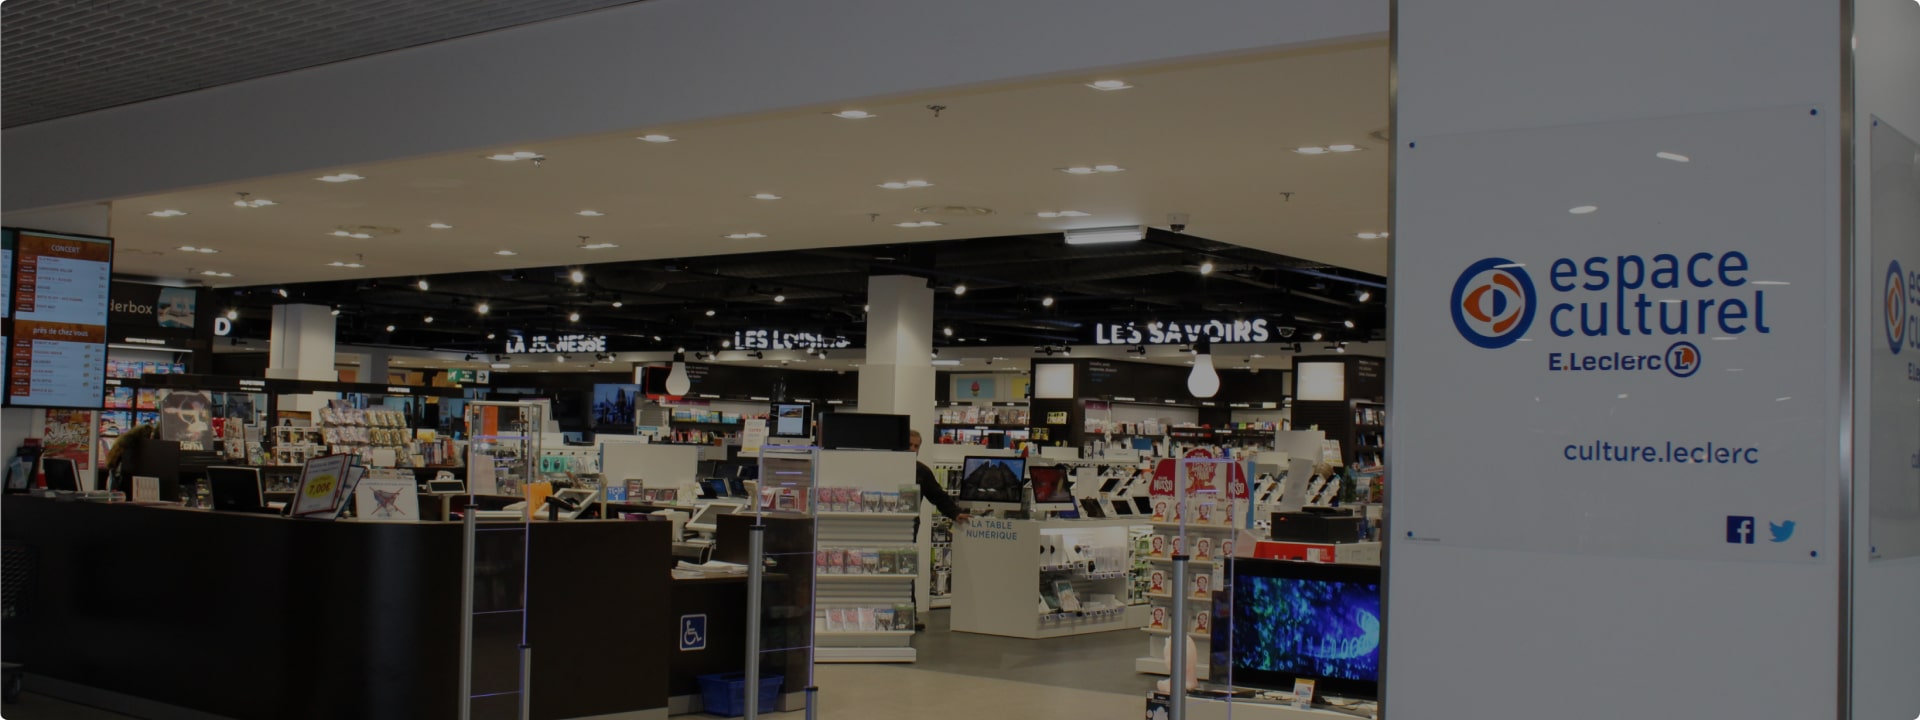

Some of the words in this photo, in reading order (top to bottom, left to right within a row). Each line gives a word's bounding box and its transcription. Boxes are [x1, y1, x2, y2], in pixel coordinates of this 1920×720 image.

[51, 244, 80, 253] CONCERT
[1550, 251, 1749, 298] espace
[1550, 291, 1771, 336] culturel
[734, 330, 769, 350] LES
[773, 331, 848, 349] LOISIS
[1096, 321, 1143, 345] LES
[1147, 318, 1270, 344] SAVOIRS
[506, 335, 525, 354] LA
[1550, 353, 1662, 371] E.Leclerc
[1564, 440, 1758, 464] culture.leclerc
[971, 519, 982, 528] LA
[985, 520, 1012, 530] TABLE
